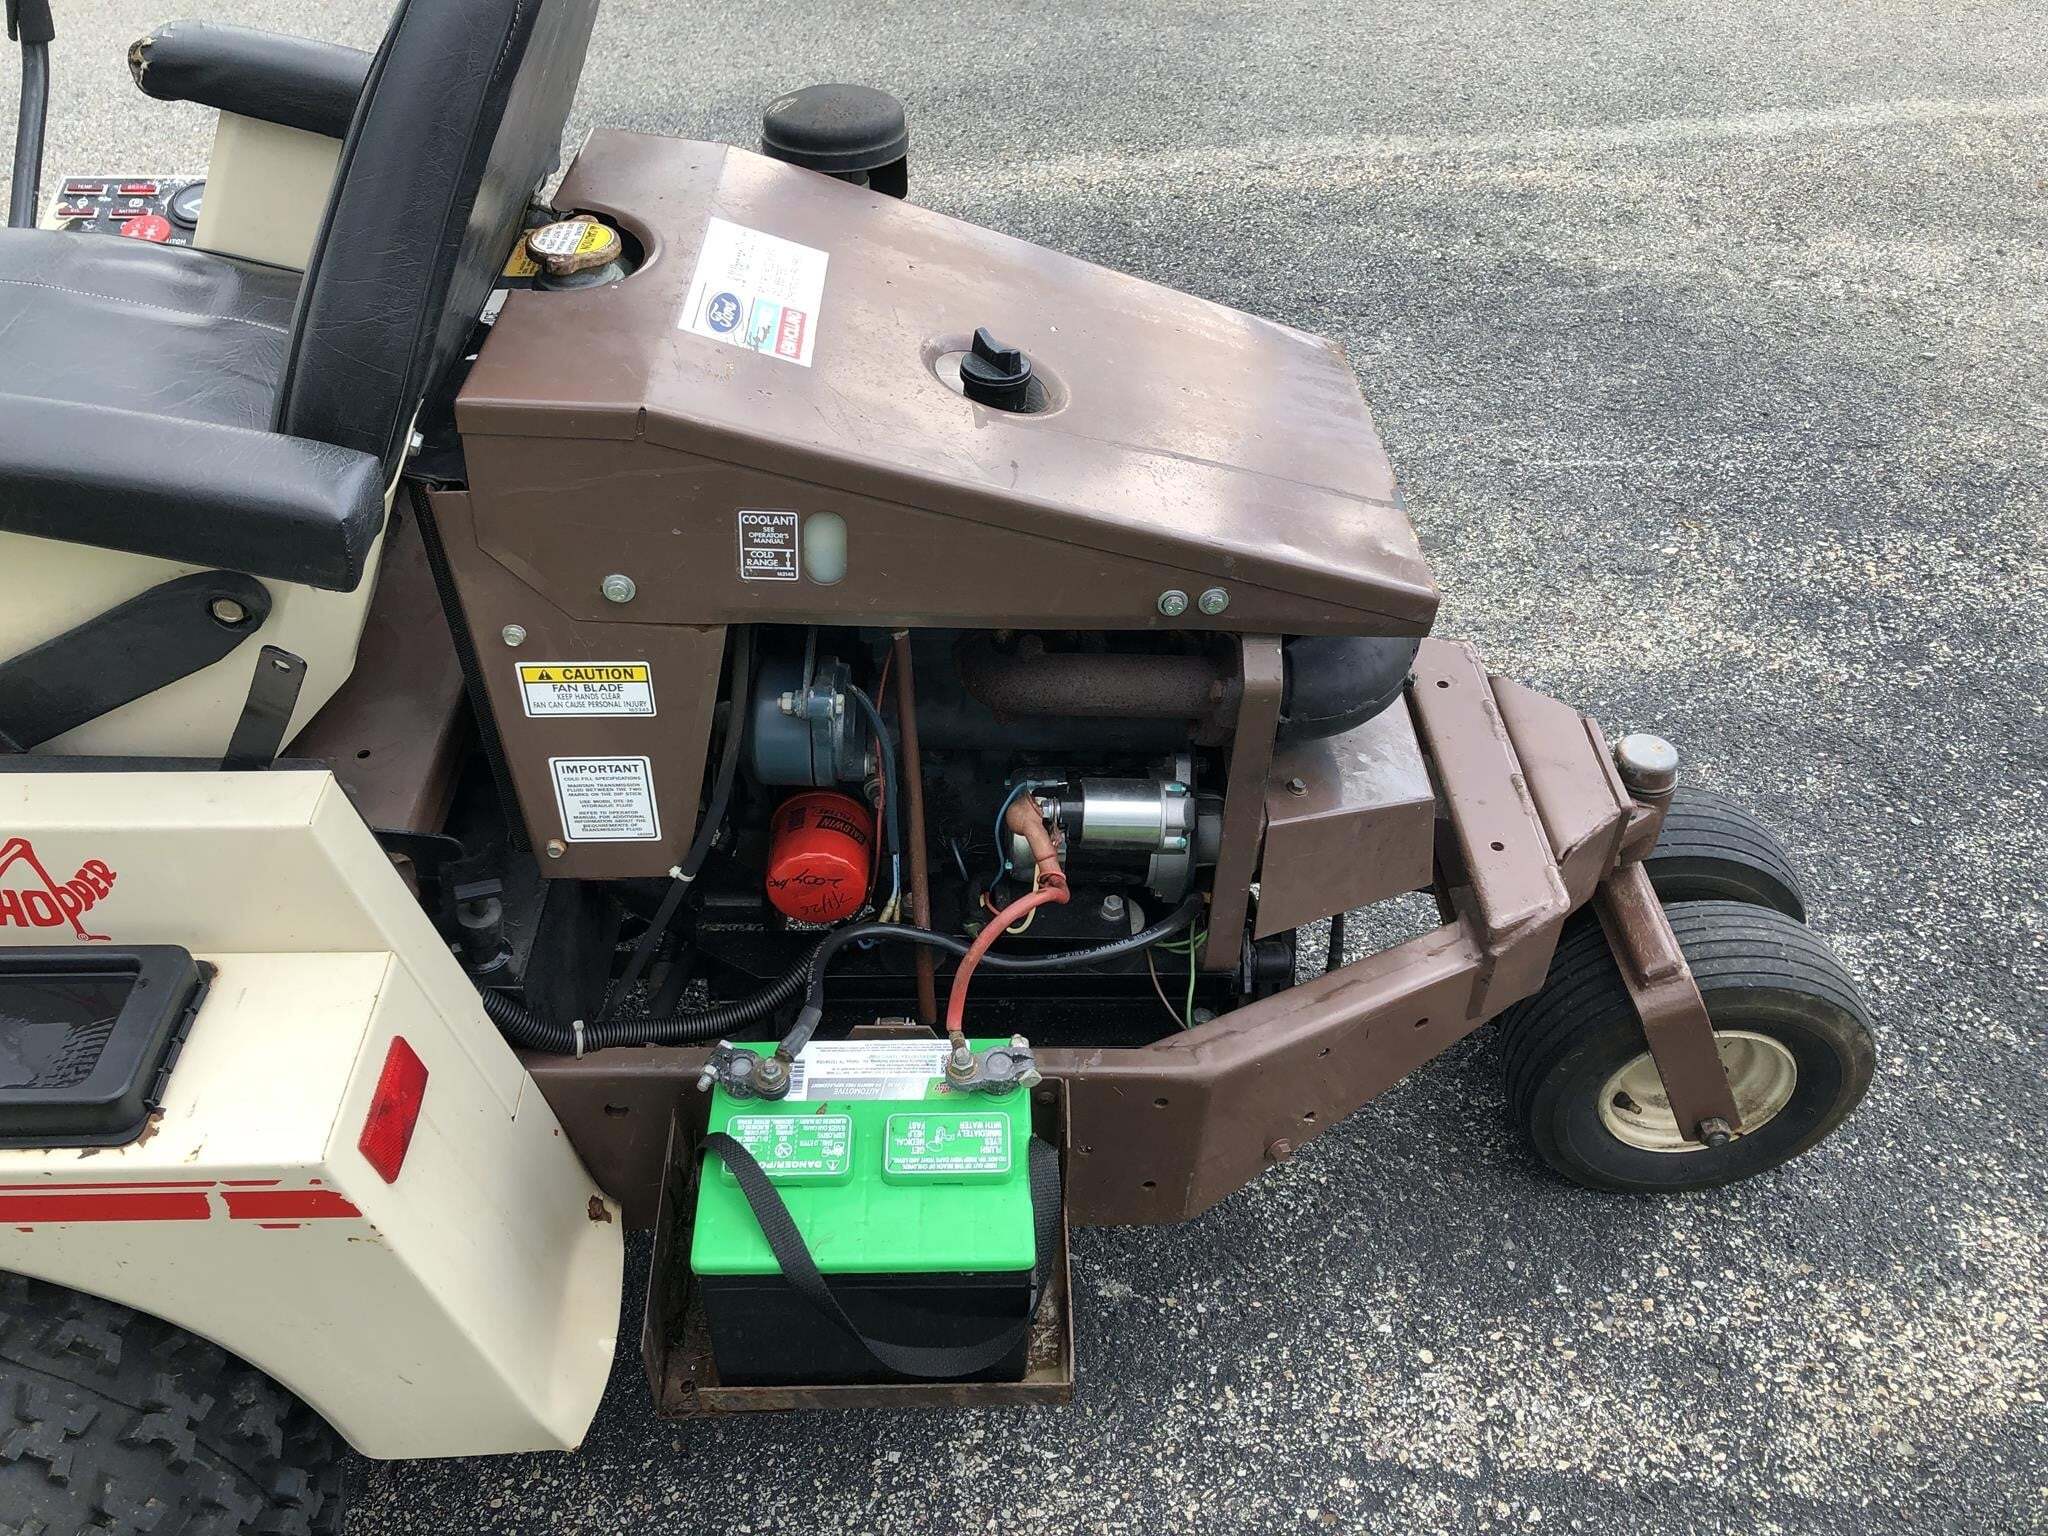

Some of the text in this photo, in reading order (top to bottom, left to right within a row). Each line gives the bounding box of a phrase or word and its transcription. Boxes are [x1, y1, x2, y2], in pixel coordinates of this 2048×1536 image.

[710, 298, 738, 328] Ford
[742, 515, 795, 526] COOLANT
[750, 551, 775, 559] COLD
[746, 558, 779, 567] RANGE
[562, 668, 635, 680] CAUTION
[552, 683, 625, 693] FAN BLADE
[601, 692, 621, 700] CLEAR
[623, 700, 648, 708] INJURY
[561, 764, 640, 774] IMPORTANT
[819, 816, 866, 842] BALDWIN
[0, 860, 117, 929] HOPPER
[833, 1087, 879, 1096] AUTOMOTIVE
[908, 1121, 925, 1130] FAST
[960, 1121, 1002, 1129] WITH WATER
[956, 1129, 1002, 1137] IMMEDIATELY
[896, 1138, 925, 1146] MEDICAL
[911, 1146, 925, 1154] GET
[759, 1160, 823, 1169] DANGER/PO
